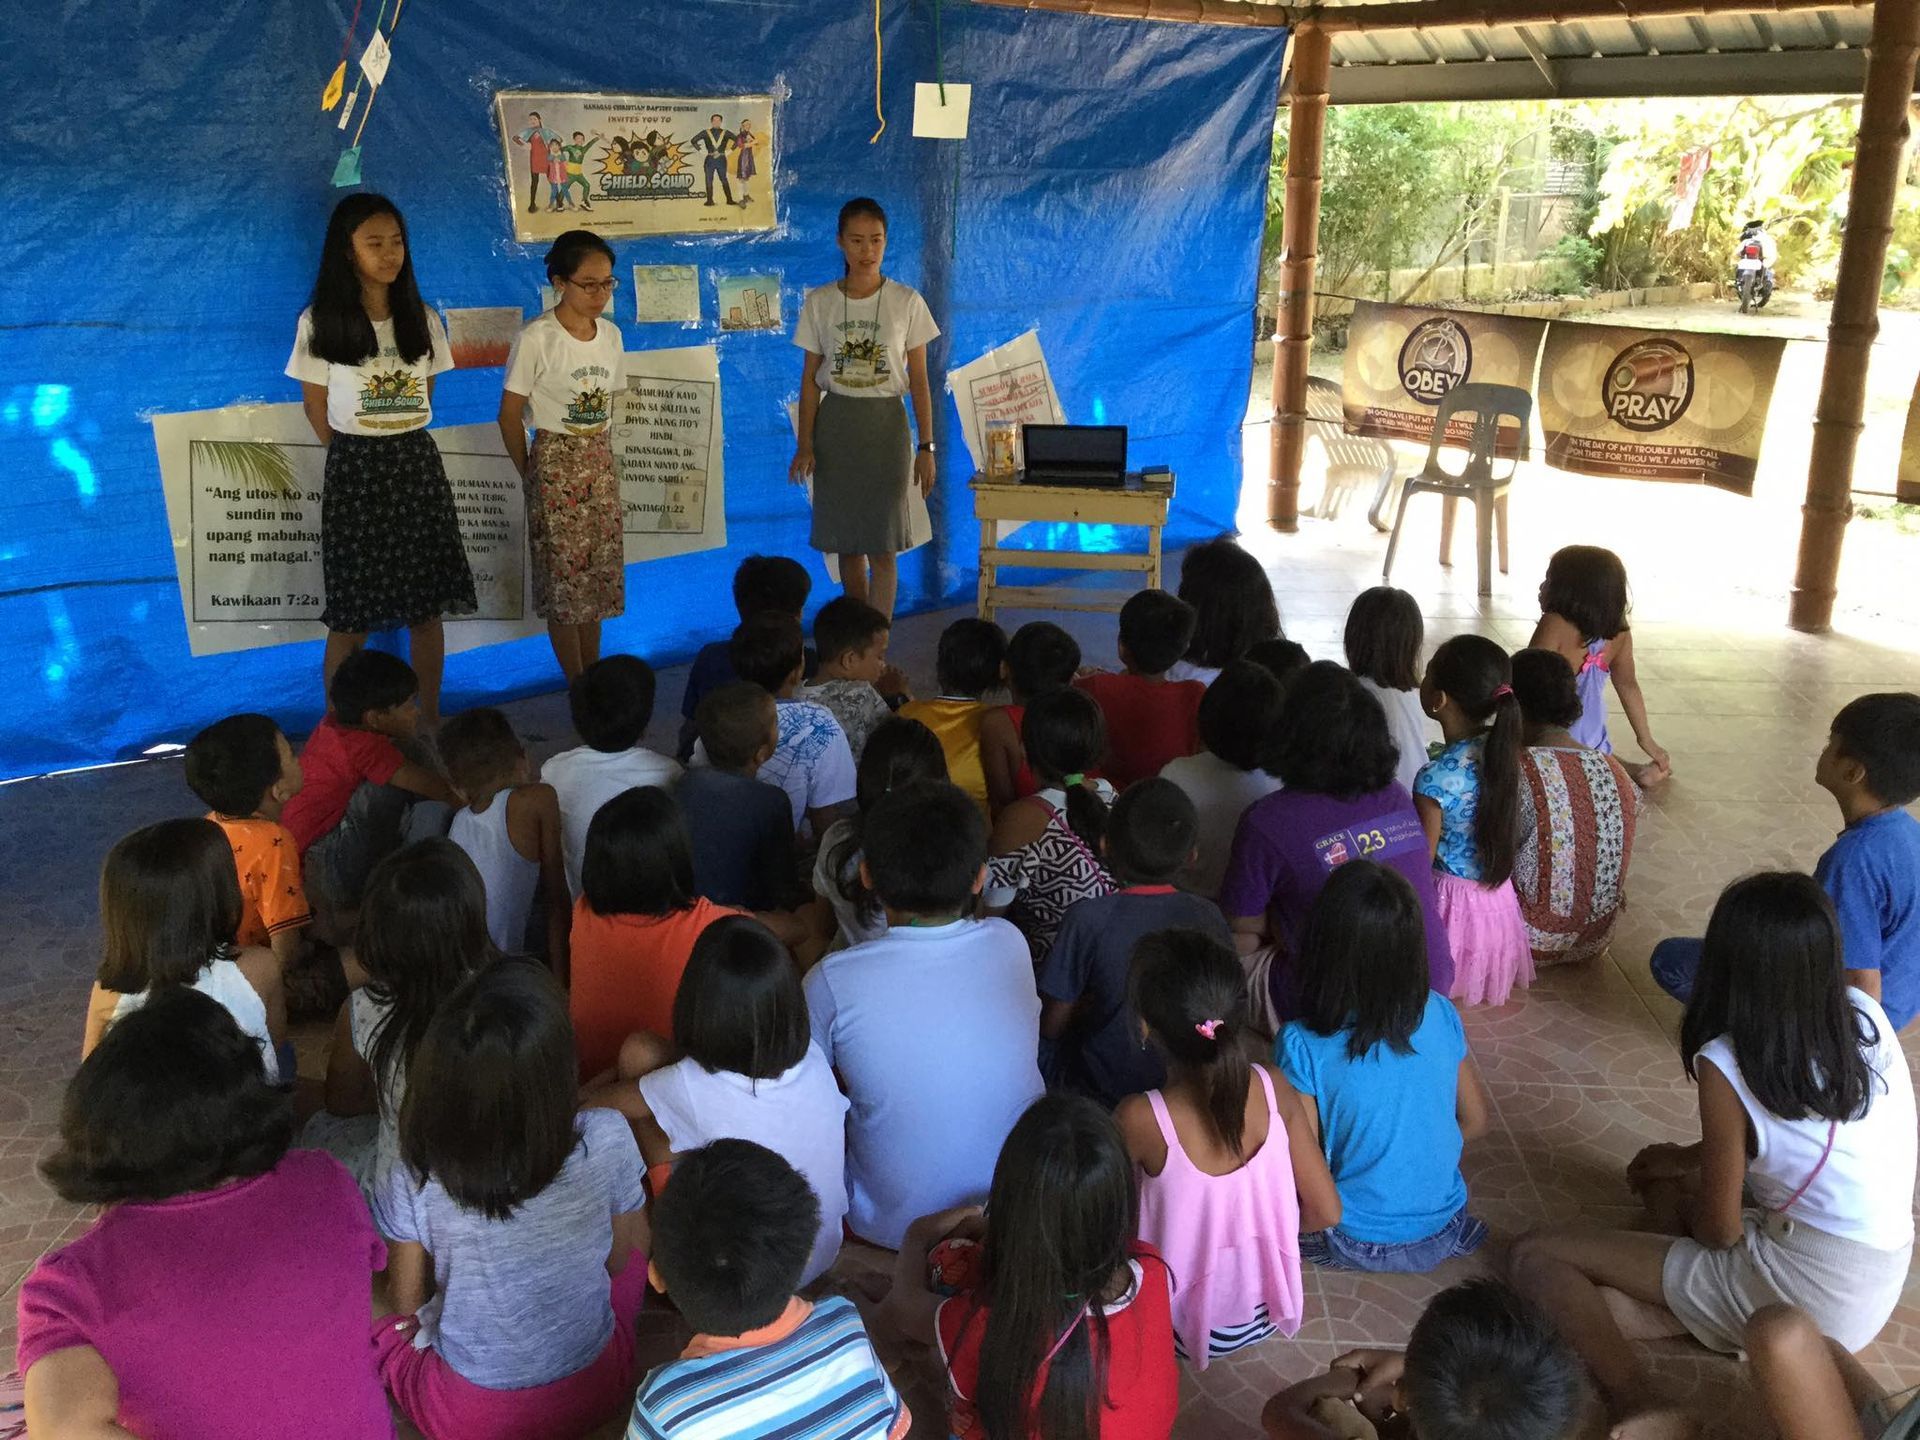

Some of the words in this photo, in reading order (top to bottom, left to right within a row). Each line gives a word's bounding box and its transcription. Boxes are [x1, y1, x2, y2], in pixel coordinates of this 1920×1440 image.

[601, 173, 648, 190] SHIELD
[651, 172, 694, 189] SQUAD
[1405, 370, 1457, 394] OBEY
[677, 391, 697, 400] KAYO
[625, 402, 646, 411] AYON
[649, 403, 658, 411] SA
[660, 404, 688, 414] SALITA
[690, 407, 700, 415] NG
[1611, 394, 1675, 420] PRAY
[654, 418, 677, 427] KUNG
[1408, 413, 1421, 422] PUT
[1414, 422, 1429, 431] MAN
[650, 432, 673, 441] HINDI
[1578, 439, 1591, 448] THE
[1592, 440, 1606, 450] DAY
[1607, 443, 1618, 451] OF
[1619, 444, 1632, 452] MY
[1635, 446, 1673, 456] TROUBLE
[1679, 448, 1698, 457] WILL
[1700, 450, 1719, 460] CALL
[1605, 453, 1622, 462] FOR
[1624, 454, 1647, 463] THOU
[1648, 455, 1669, 464] WILT
[1671, 457, 1706, 466] ANSWER
[654, 461, 678, 470] NINYO
[680, 462, 696, 471] ANG
[457, 480, 490, 489] DUMAAN
[493, 480, 504, 489] KA
[505, 481, 516, 489] NG
[625, 474, 655, 483] INYONG
[246, 488, 277, 500] utos
[282, 488, 301, 500] Ko
[306, 491, 322, 504] ay
[469, 493, 479, 501] NA
[226, 509, 276, 520] sundin
[281, 511, 303, 521] mo
[468, 520, 479, 528] KA
[482, 520, 498, 528] MAN
[206, 530, 252, 543] upang
[257, 530, 322, 544] mabuhay
[472, 532, 496, 540] HINDI
[209, 551, 245, 564] nang
[211, 594, 281, 606] Kawikaan
[287, 594, 319, 606] 7:2a
[1315, 832, 1346, 850] GRACE
[1357, 829, 1386, 854] 23
